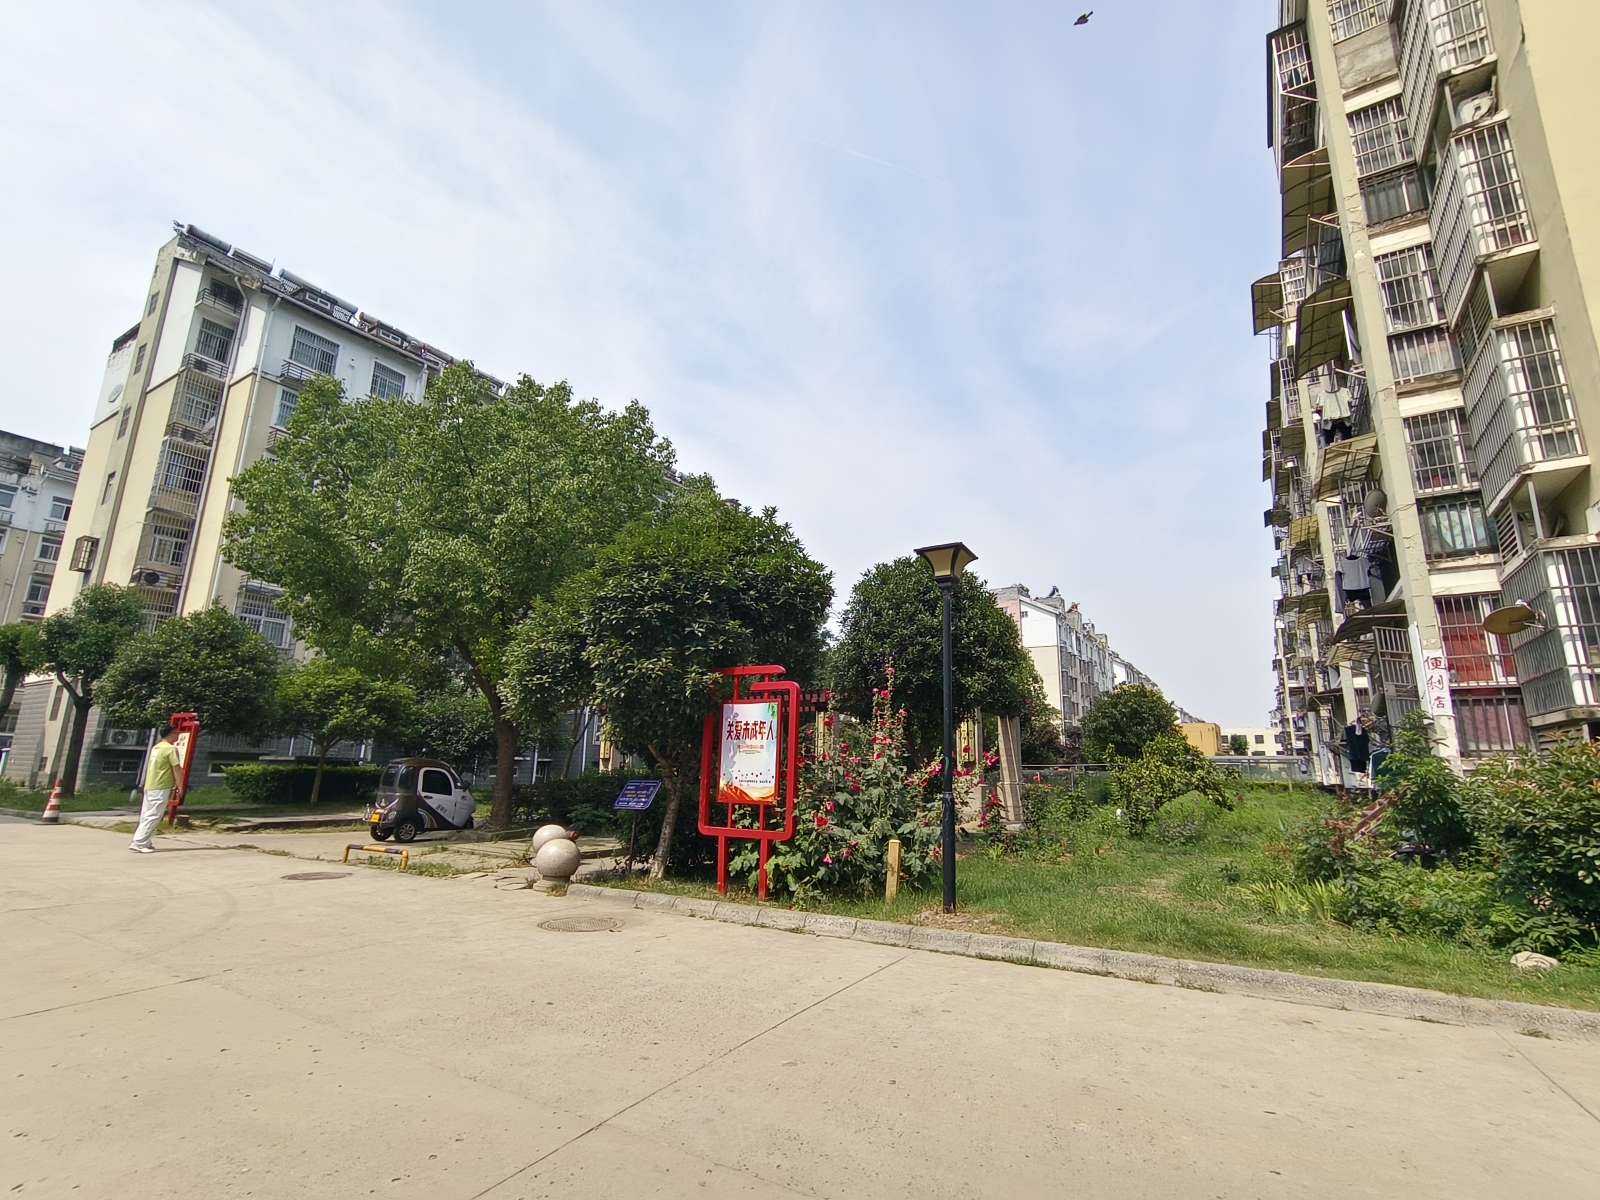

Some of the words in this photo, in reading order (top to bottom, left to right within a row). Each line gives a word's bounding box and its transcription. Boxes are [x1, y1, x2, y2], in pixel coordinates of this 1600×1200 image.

[1424, 656, 1447, 709] 便利店
[726, 720, 774, 741] 关爱未成年人
